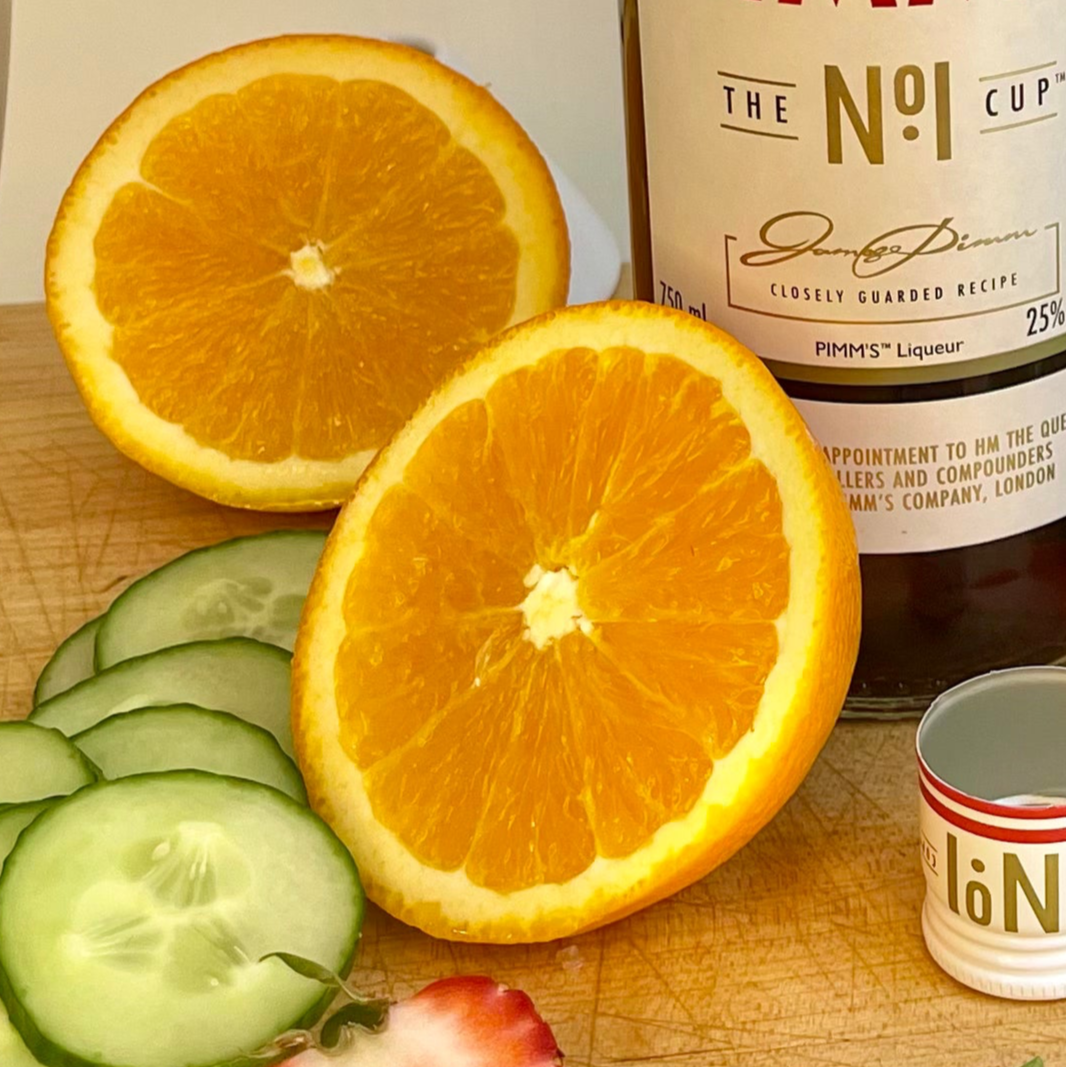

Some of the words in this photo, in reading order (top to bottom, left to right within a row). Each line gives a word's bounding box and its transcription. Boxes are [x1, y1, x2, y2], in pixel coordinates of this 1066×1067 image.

[723, 86, 788, 123] THE
[660, 280, 683, 310] 750
[770, 282, 845, 303] CLOSELY
[857, 286, 944, 303] GUARDED
[957, 272, 1018, 297] RECIPE
[1026, 297, 1065, 336] 25%
[896, 339, 964, 360] Liqueur
[945, 442, 966, 461] TO
[975, 436, 1000, 456] HM
[1006, 426, 1034, 449] THE
[893, 469, 928, 488] AND
[936, 442, 1053, 485] COMPOUNDERS
[845, 493, 894, 511] MM'S
[902, 488, 988, 511] COMPANY,
[995, 463, 1056, 497] LONDON
